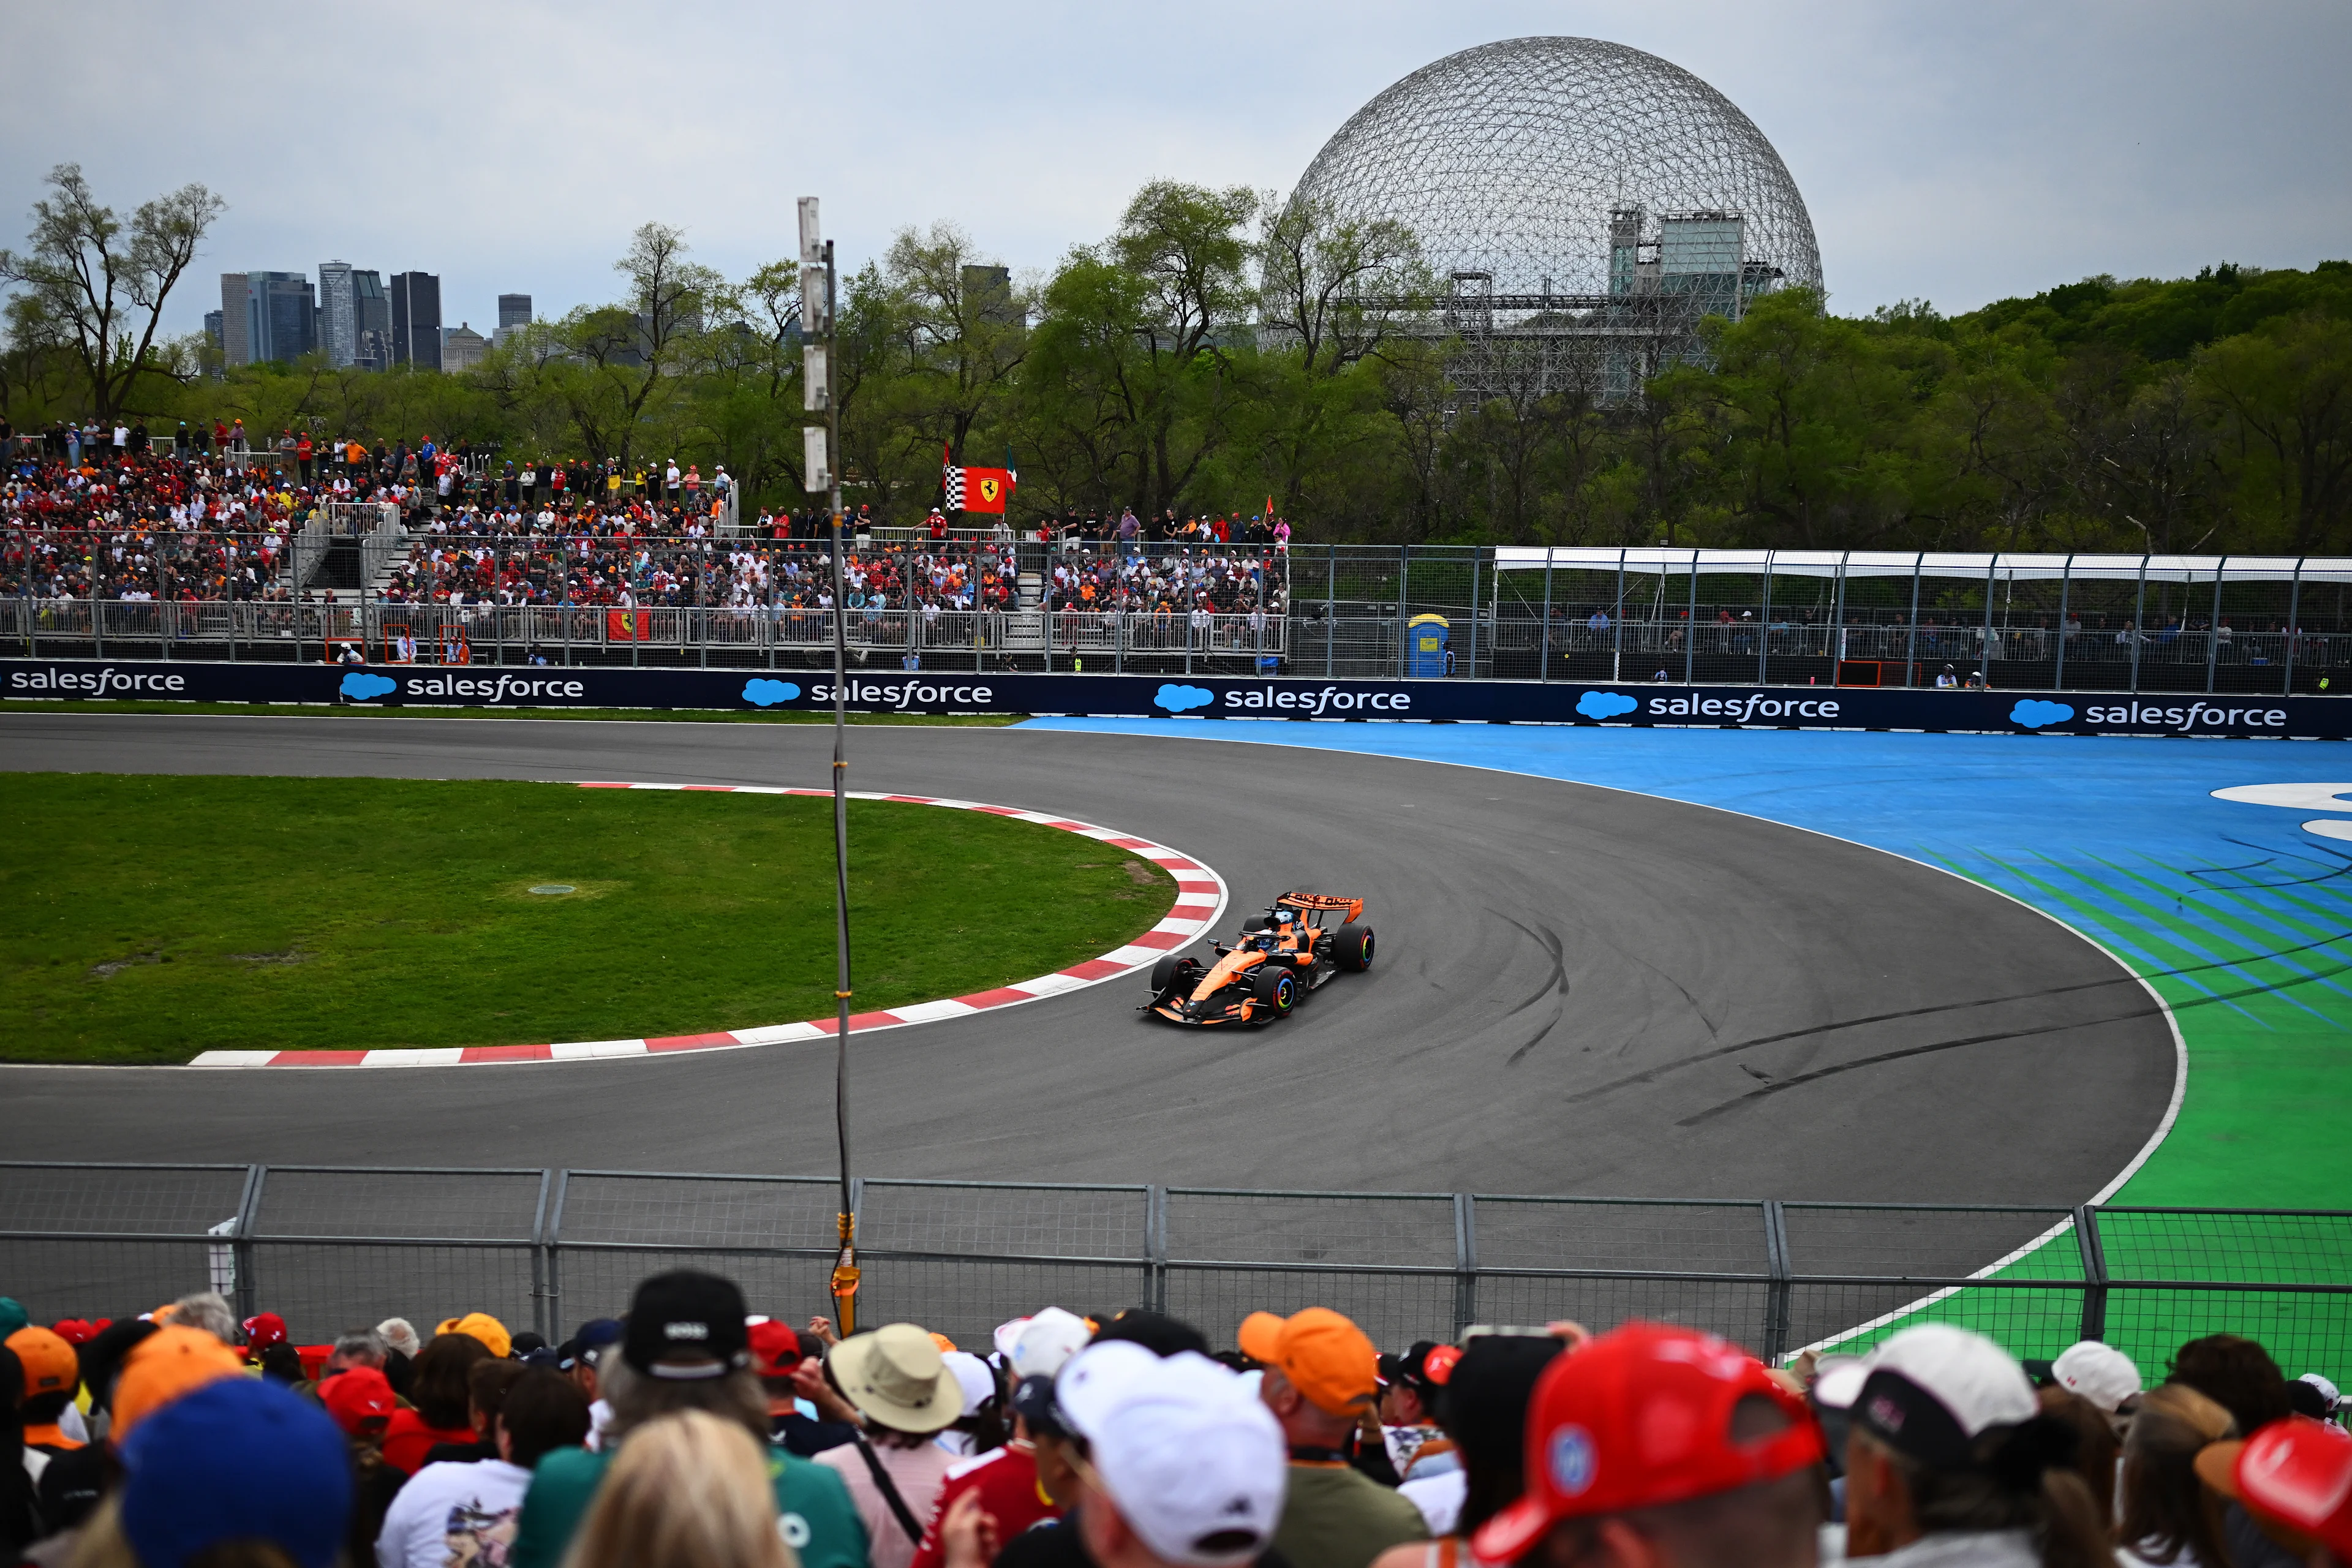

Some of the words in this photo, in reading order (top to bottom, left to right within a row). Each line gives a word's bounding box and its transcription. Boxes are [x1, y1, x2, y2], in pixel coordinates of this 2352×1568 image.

[11, 668, 184, 696] salesforce
[407, 674, 584, 703] salesforce
[811, 680, 992, 709] salesforce
[1224, 685, 1411, 715] salesforce
[1648, 693, 1839, 723] salesforce
[2086, 701, 2286, 731] salesforce
